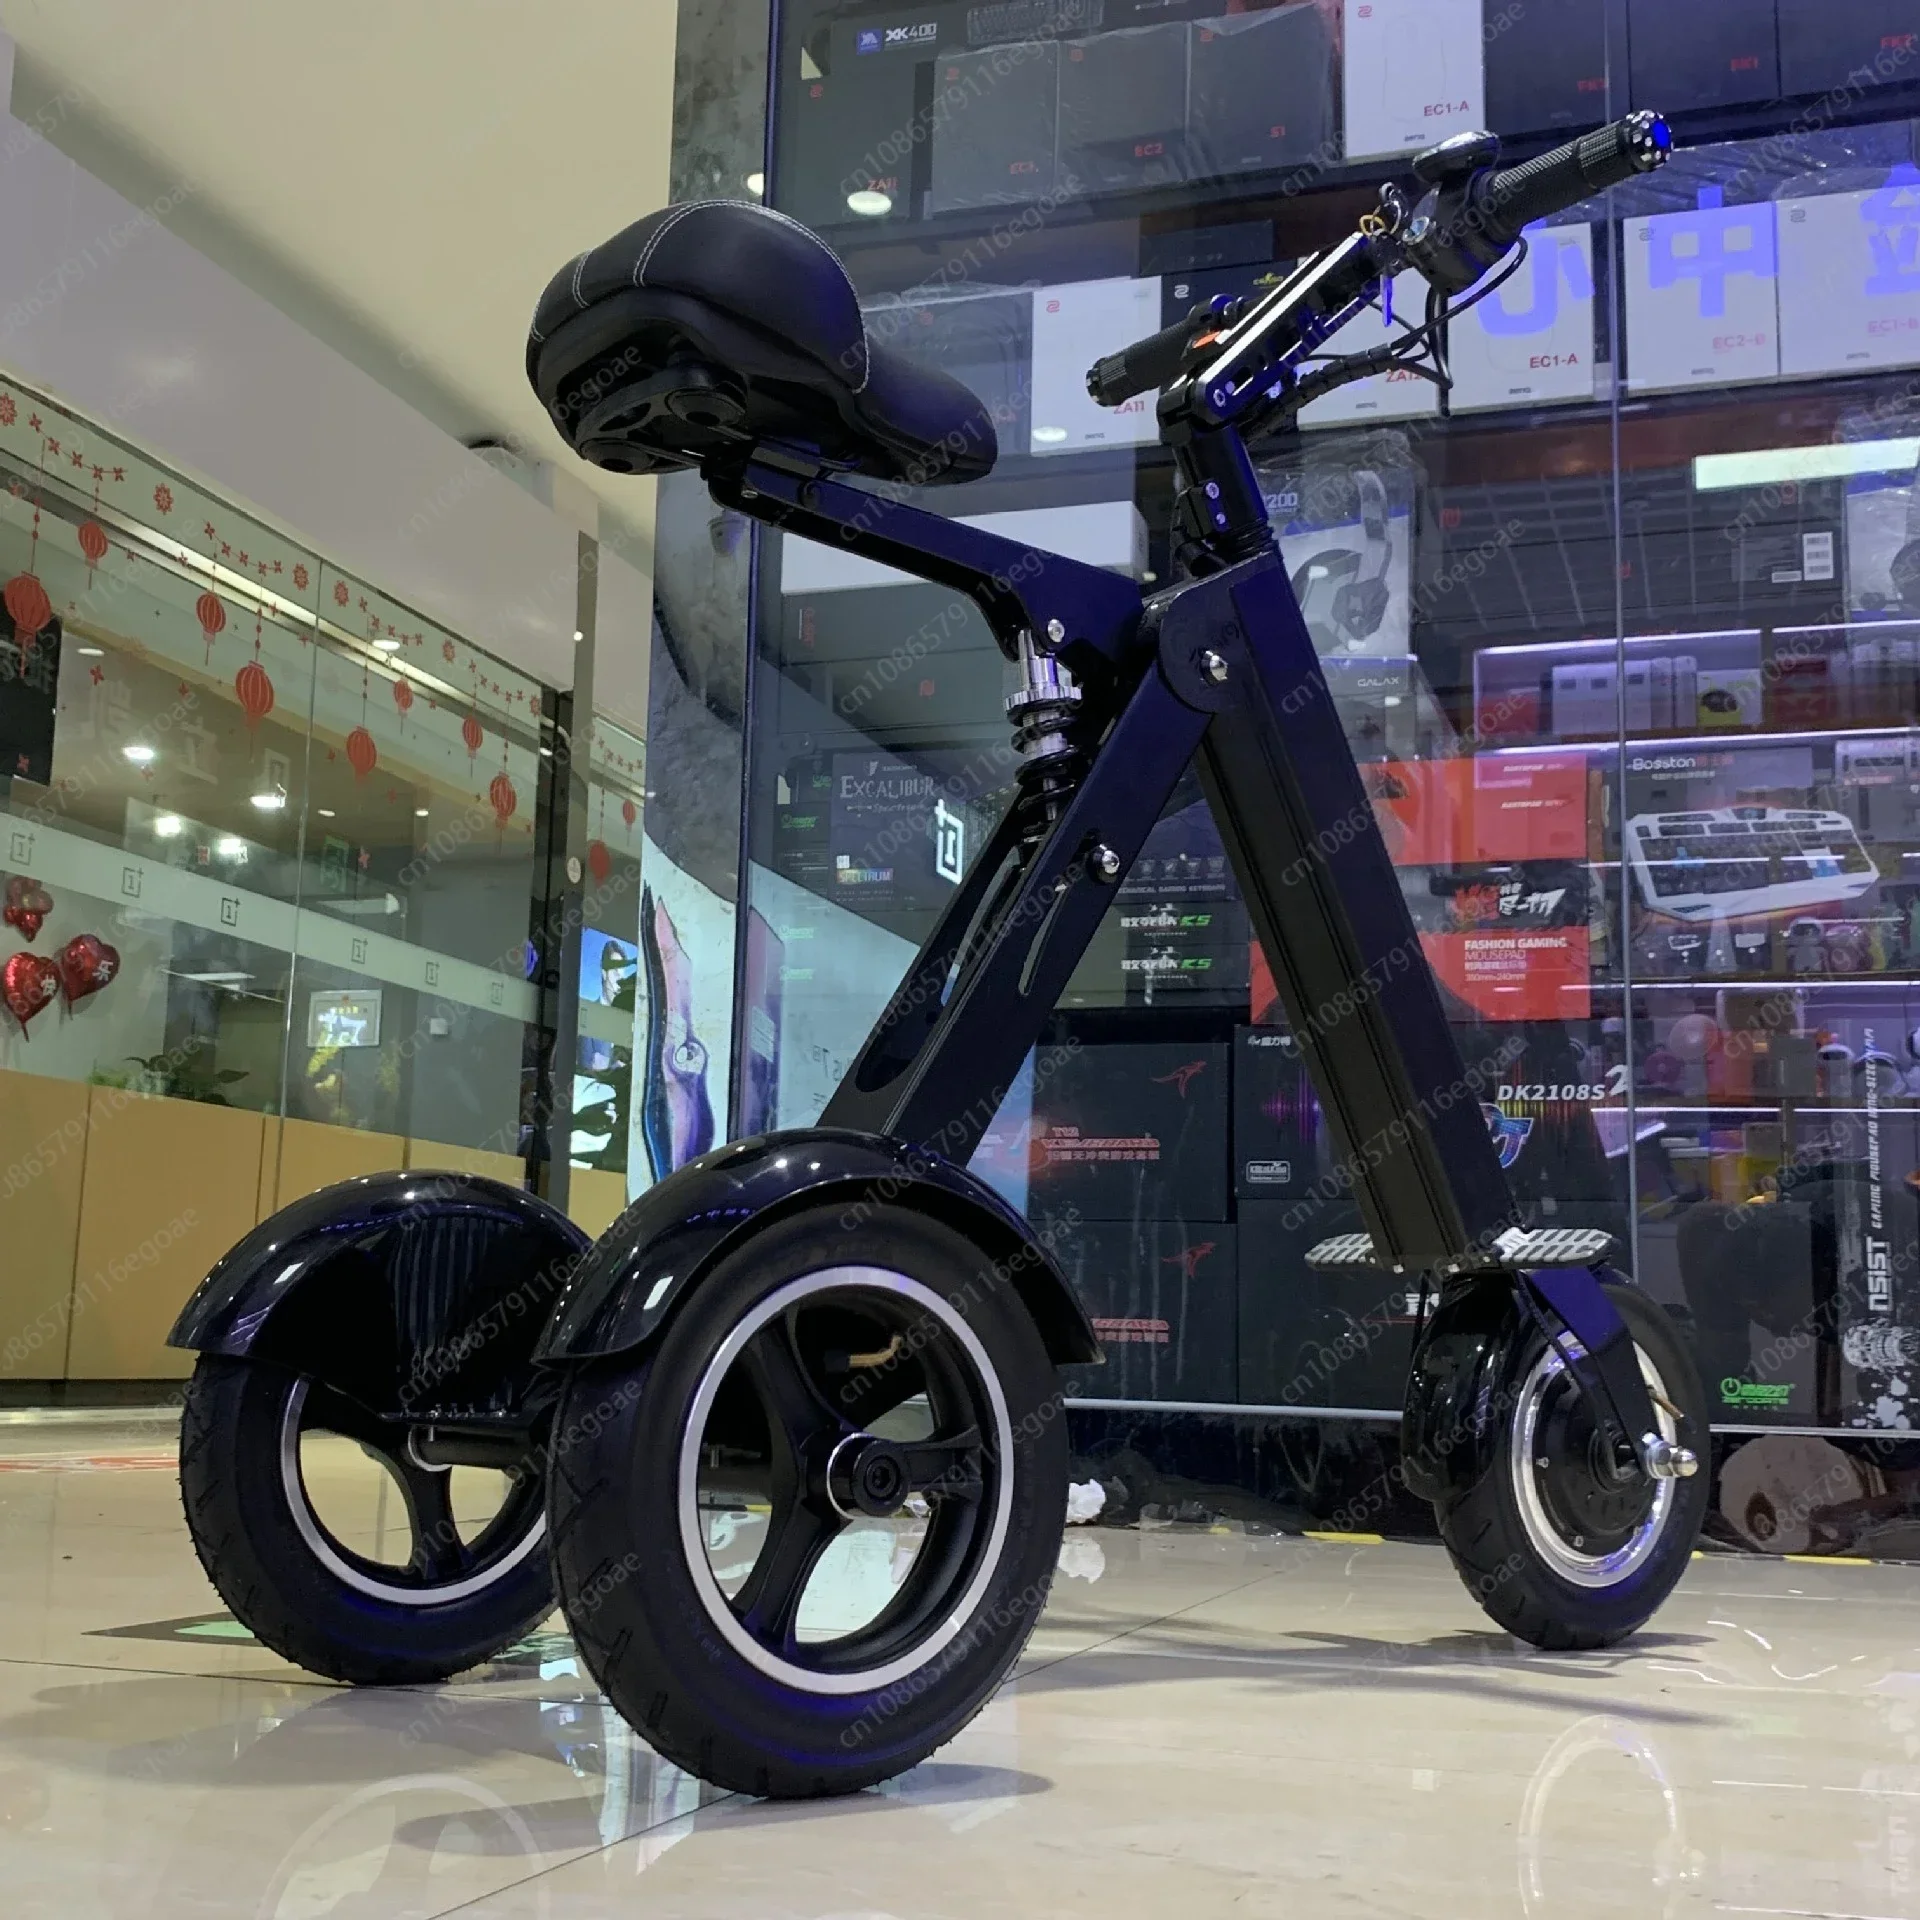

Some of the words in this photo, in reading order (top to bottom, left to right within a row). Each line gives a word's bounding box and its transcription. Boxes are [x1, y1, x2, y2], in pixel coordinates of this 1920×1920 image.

[885, 23, 937, 42] XK400
[1423, 100, 1470, 117] EC1-A
[1529, 353, 1579, 369] EC1-A
[1357, 676, 1400, 687] GALAX
[839, 775, 936, 799] EXCALIBUR
[1464, 938, 1515, 950] FASHION
[1517, 936, 1568, 949] GAMING
[1464, 950, 1527, 961] MOUSEPAD
[1497, 1084, 1606, 1101] DK2108S
